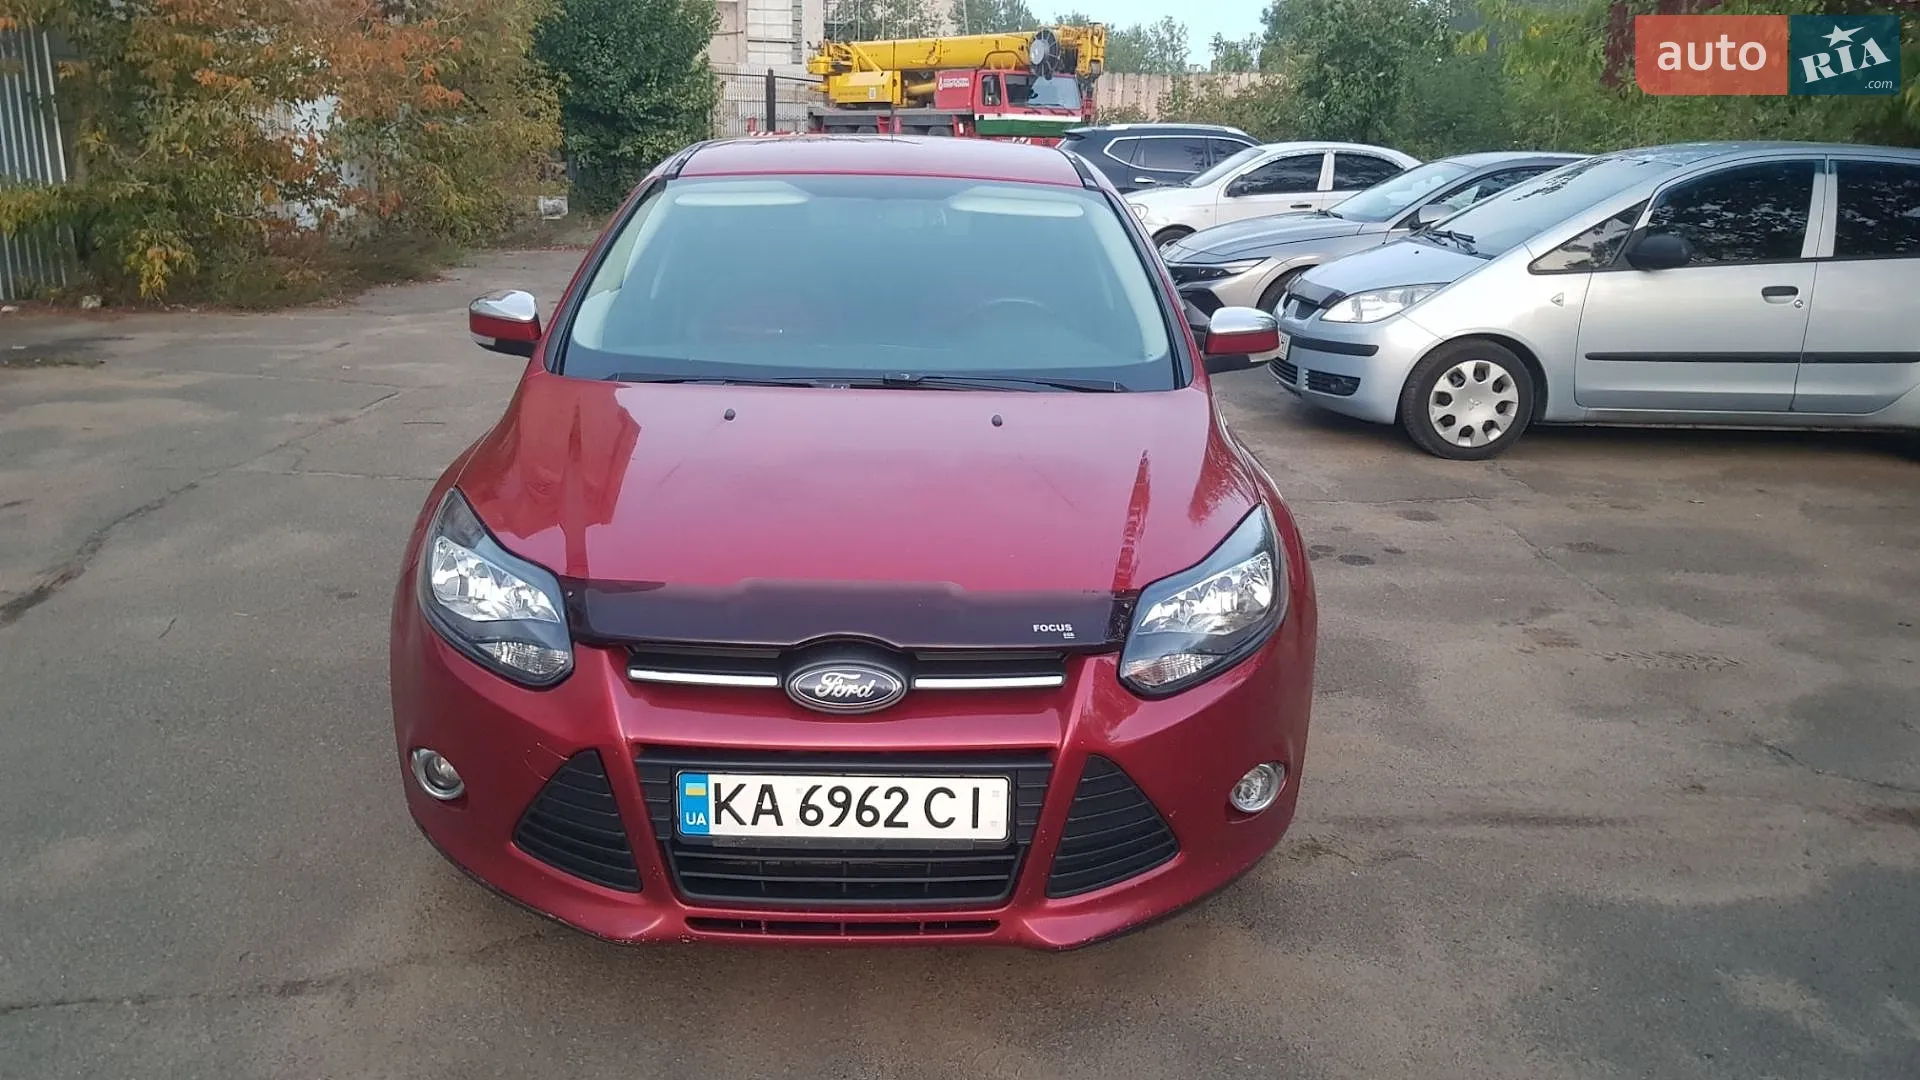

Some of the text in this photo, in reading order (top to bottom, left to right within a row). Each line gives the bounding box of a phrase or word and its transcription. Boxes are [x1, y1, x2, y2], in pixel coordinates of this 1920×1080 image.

[1032, 623, 1073, 632] FOCUS
[814, 672, 876, 698] Ford
[714, 782, 784, 827] KA
[798, 784, 910, 829] 6962
[686, 812, 707, 826] UA
